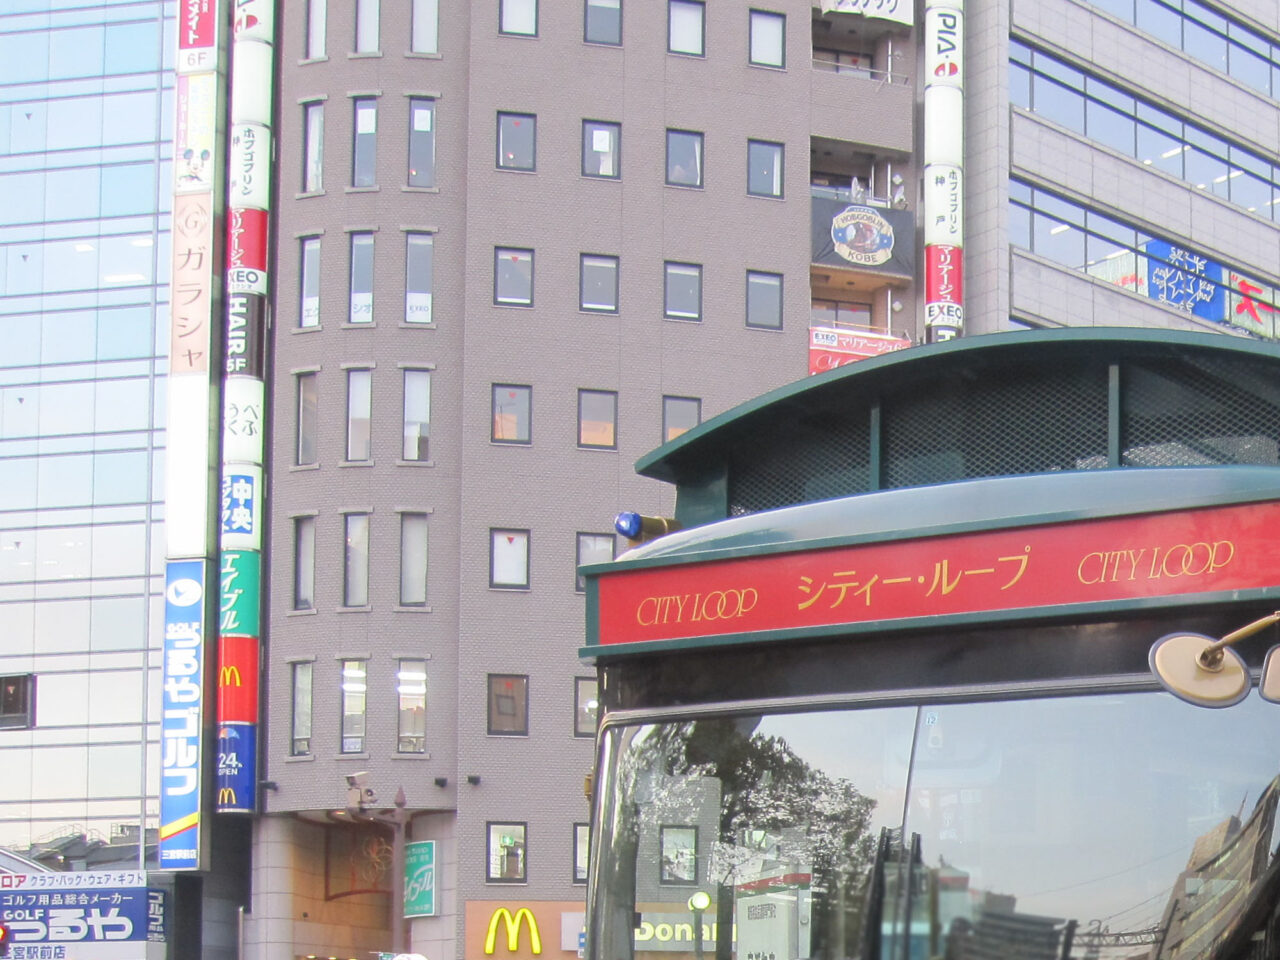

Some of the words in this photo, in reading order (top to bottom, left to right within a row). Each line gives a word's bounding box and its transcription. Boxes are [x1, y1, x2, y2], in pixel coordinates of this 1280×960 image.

[187, 52, 207, 66] 6F
[848, 250, 879, 263] KOBE
[937, 245, 954, 302] マリアージュ
[229, 270, 259, 284] XEO
[176, 246, 206, 368] ガラシャ
[227, 297, 248, 356] HAIR
[928, 304, 962, 321] EXEO
[814, 332, 837, 342] EXEO
[232, 478, 252, 531] 中央
[797, 545, 1031, 612] シティー・ループ
[1078, 549, 1146, 586] CITY
[1147, 540, 1235, 579] LOOP
[221, 554, 243, 630] エイブル
[636, 592, 690, 627] CITY
[690, 588, 758, 622] LOOP
[163, 632, 201, 797] つるやゴルフ
[3, 892, 134, 907] ゴルフ用品総合メーカー
[3, 908, 45, 921] GOLF
[4, 907, 134, 942] つるや
